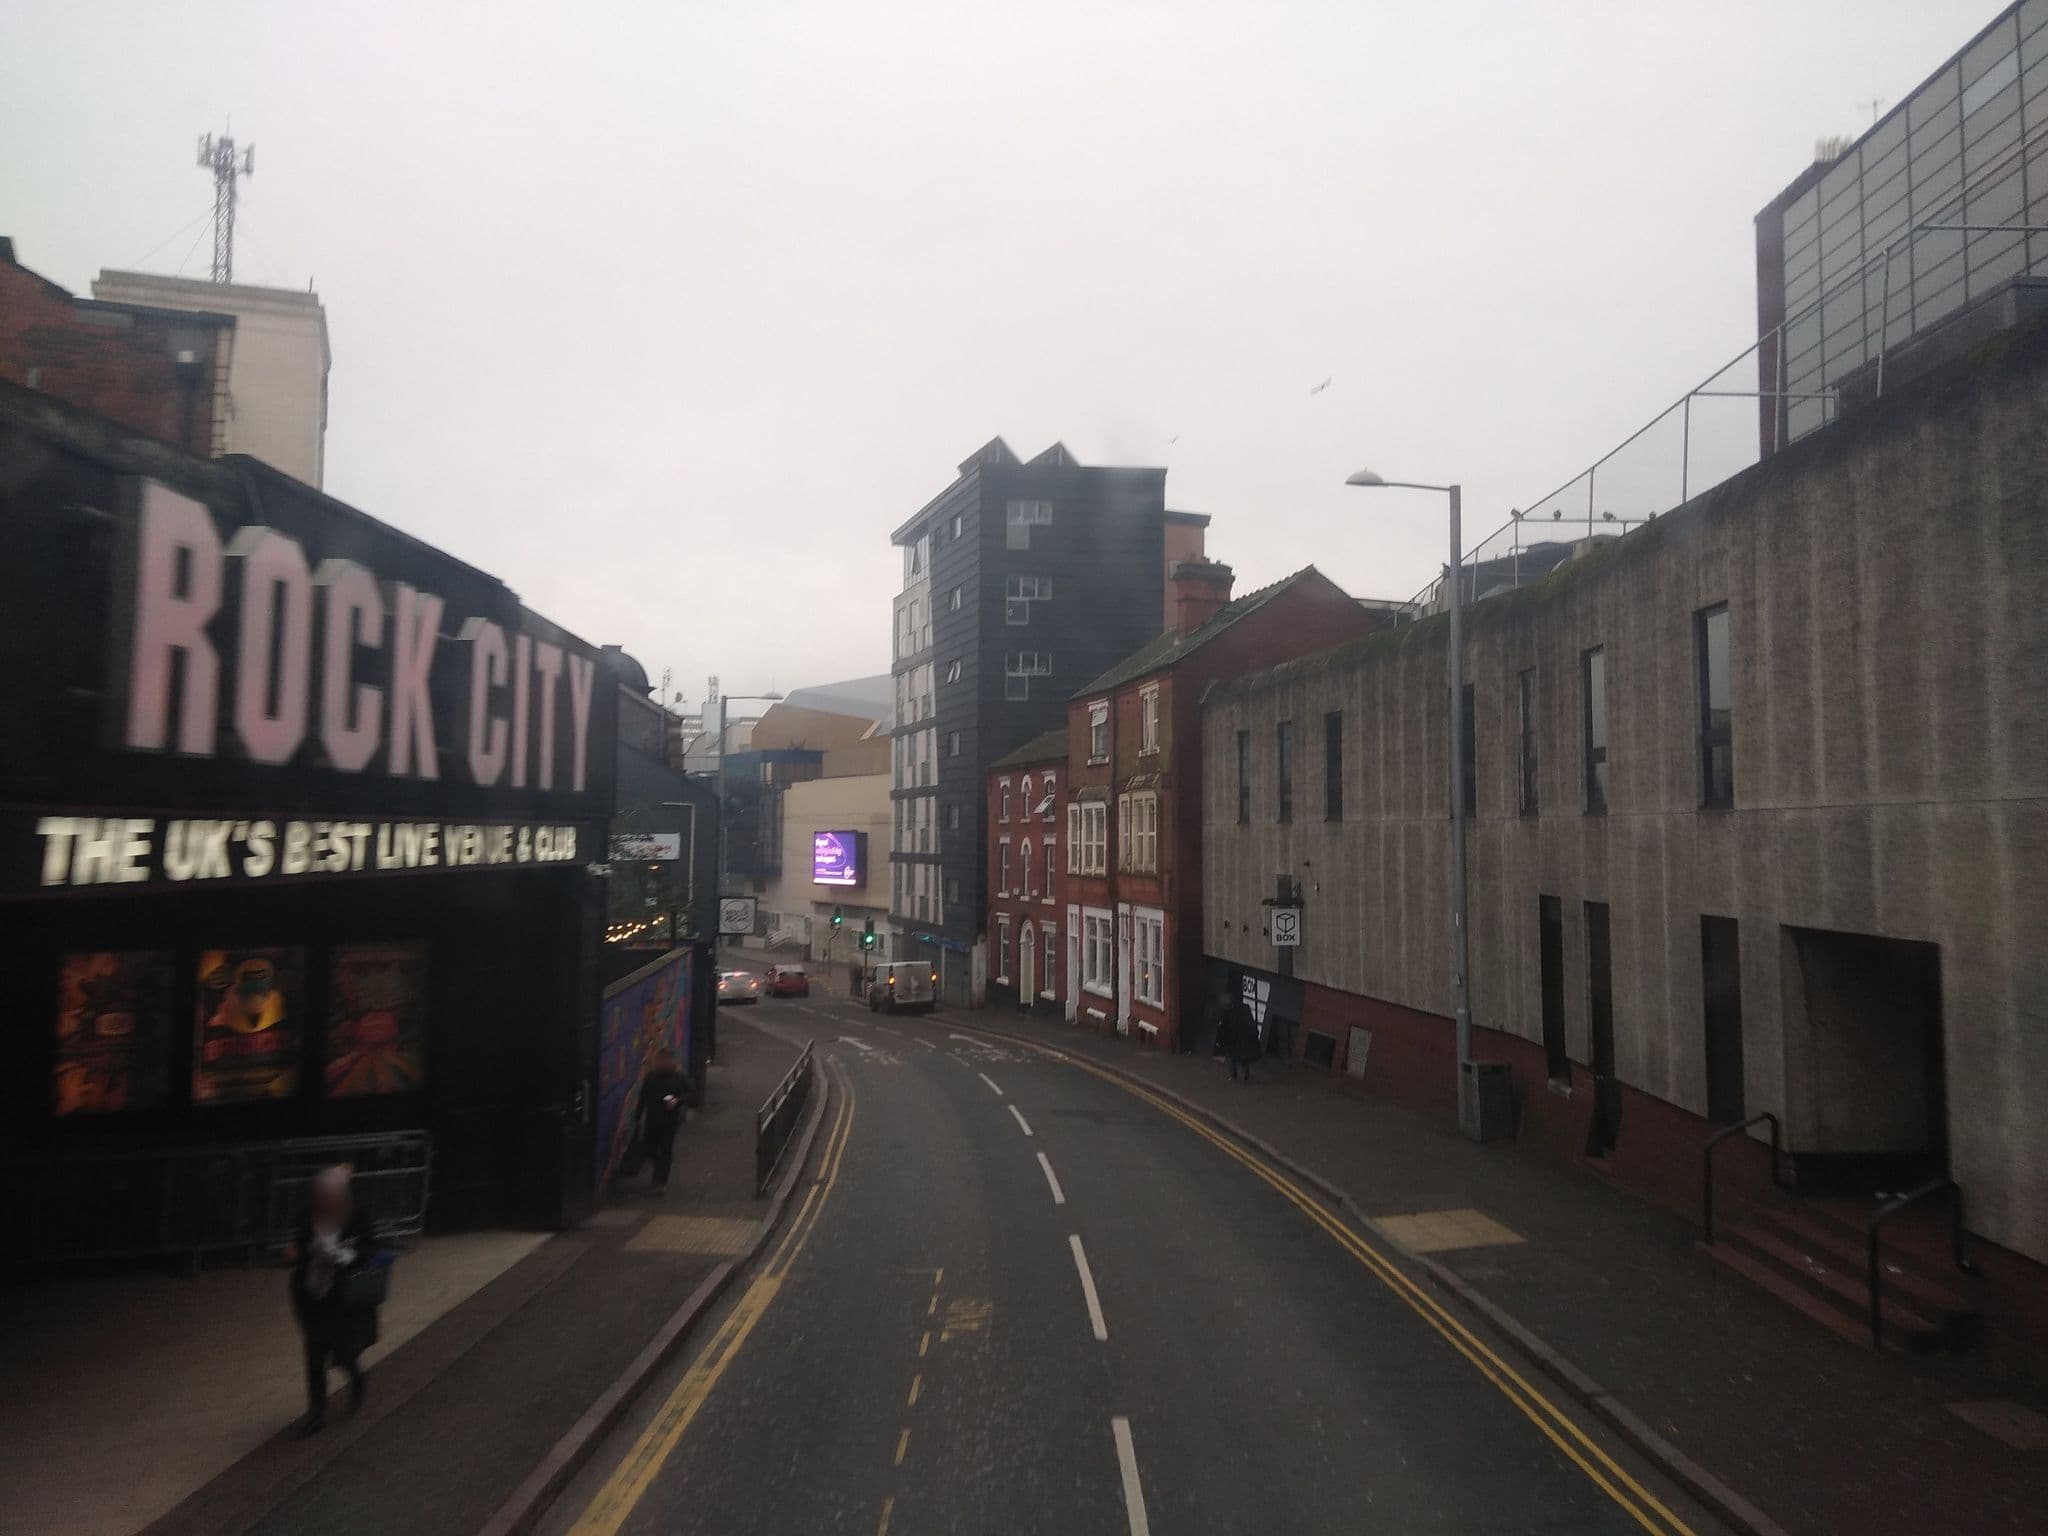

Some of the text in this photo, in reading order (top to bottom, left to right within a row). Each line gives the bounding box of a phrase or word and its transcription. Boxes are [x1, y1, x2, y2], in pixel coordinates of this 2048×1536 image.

[126, 478, 594, 792] ROCK CITY
[35, 816, 156, 886] THE
[162, 819, 278, 881] UK'S
[281, 820, 372, 874] BEST
[376, 822, 440, 870] LIVE
[516, 825, 532, 863] &
[535, 825, 577, 862] CLUB
[1276, 933, 1296, 942] BOX
